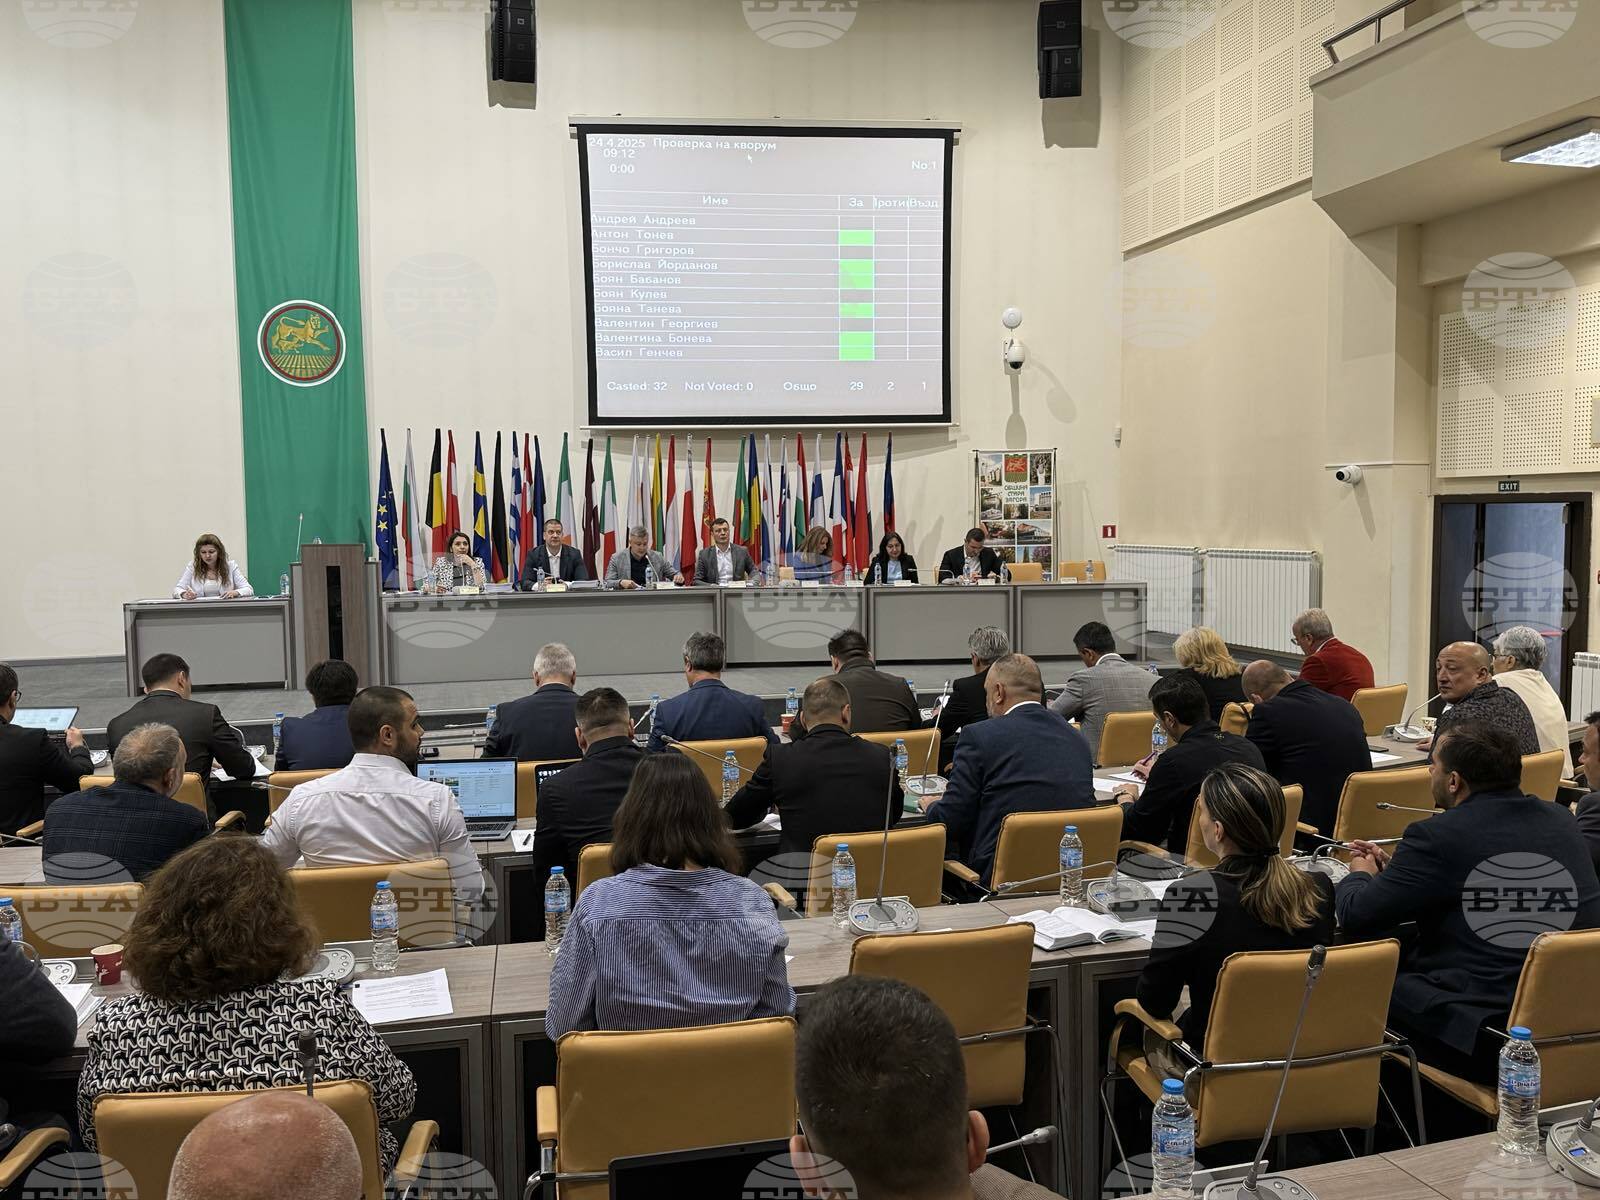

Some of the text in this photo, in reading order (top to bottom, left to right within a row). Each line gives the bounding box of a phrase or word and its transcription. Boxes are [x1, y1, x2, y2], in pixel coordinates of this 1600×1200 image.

[653, 138, 712, 149] Проверка
[716, 141, 730, 150] на
[734, 141, 777, 152] кворум
[609, 164, 635, 174] 0:00
[849, 197, 864, 207] За
[643, 215, 696, 225] Андреев
[635, 229, 674, 239] Тонев
[637, 244, 695, 256] Григоров
[658, 258, 718, 271] Йорданов
[630, 273, 681, 284] Бабанов
[630, 289, 667, 300] Кулев
[638, 303, 682, 313] Танева
[661, 318, 718, 330] Георгиев
[668, 332, 712, 343] Бонева
[639, 347, 683, 357] Генчев
[653, 381, 668, 391] 32
[684, 381, 754, 391] Not Voted: 0
[850, 381, 865, 391] 29
[887, 382, 895, 391] 2
[1500, 482, 1518, 490] EXIT
